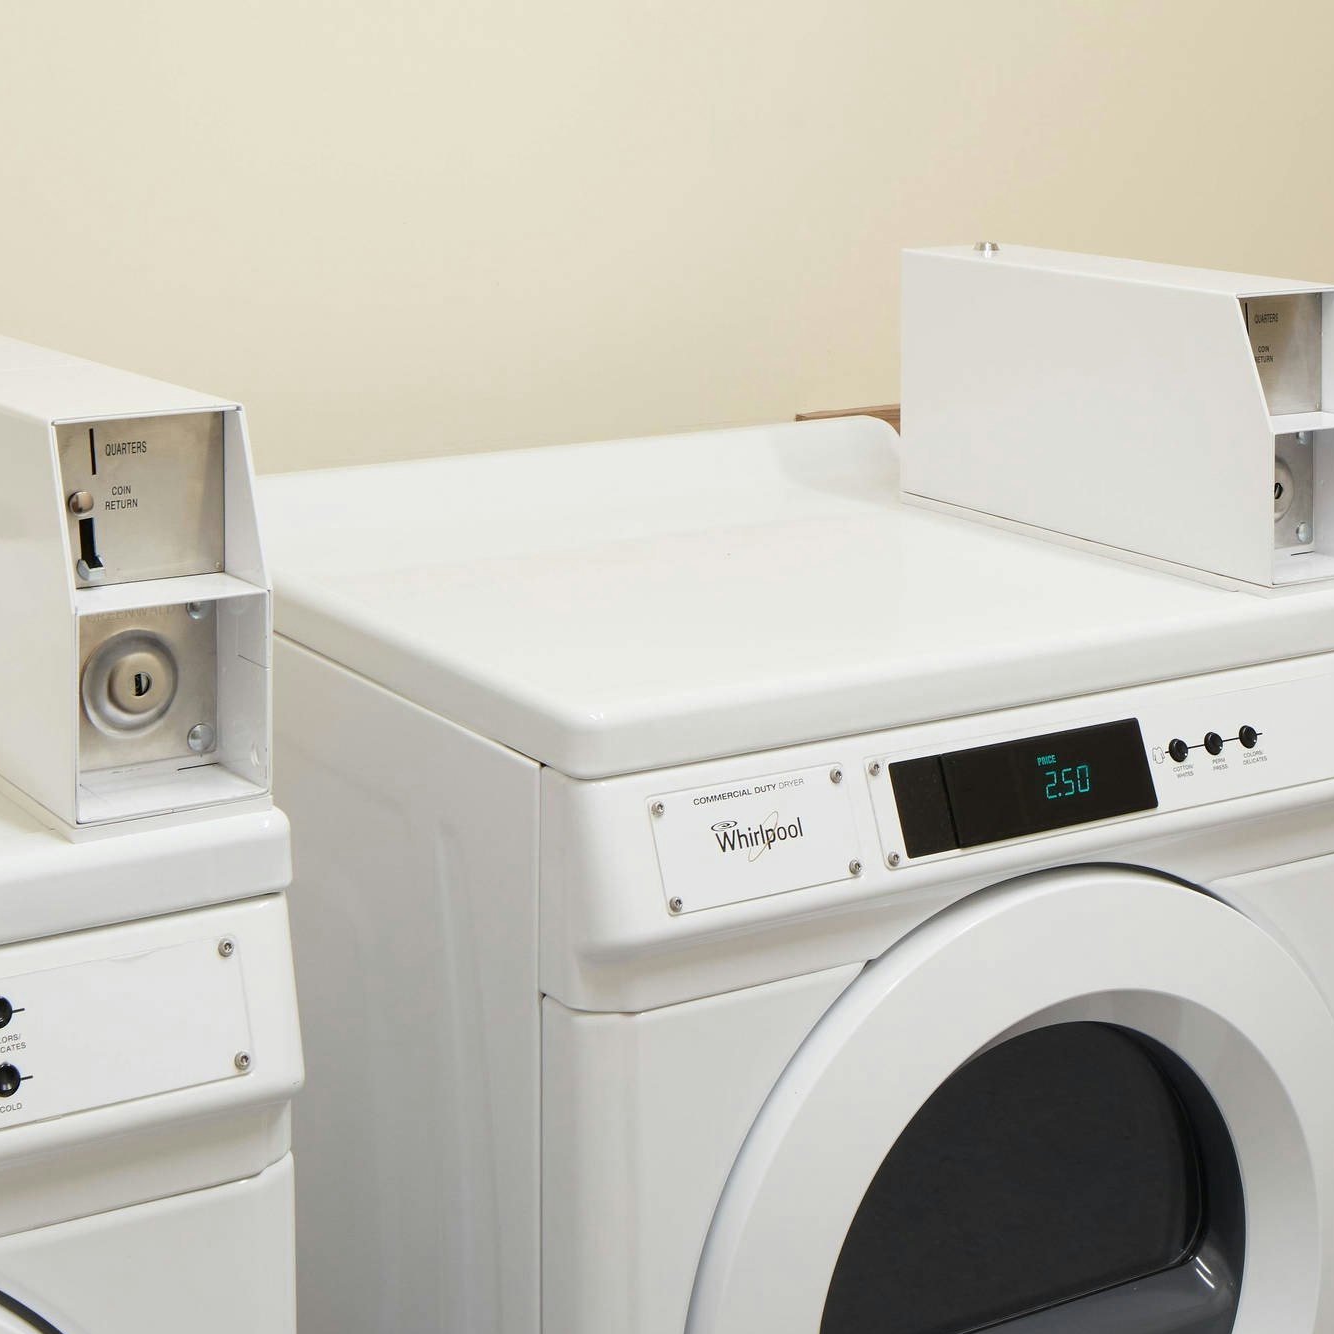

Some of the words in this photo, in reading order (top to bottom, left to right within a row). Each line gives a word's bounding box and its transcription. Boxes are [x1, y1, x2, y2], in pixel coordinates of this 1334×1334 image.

[1254, 312, 1279, 324] QUARTERS
[105, 441, 147, 456] QUARTERS
[111, 485, 131, 496] COIN
[105, 499, 138, 510] RETURN
[1037, 754, 1056, 766] PRICE
[1045, 764, 1090, 799] 2.50
[693, 788, 752, 806] COMMERCIAL
[754, 784, 777, 794] DUTY
[778, 778, 804, 790] DRYER
[715, 817, 803, 853] Whirlpool
[0, 1103, 23, 1114] COLD
